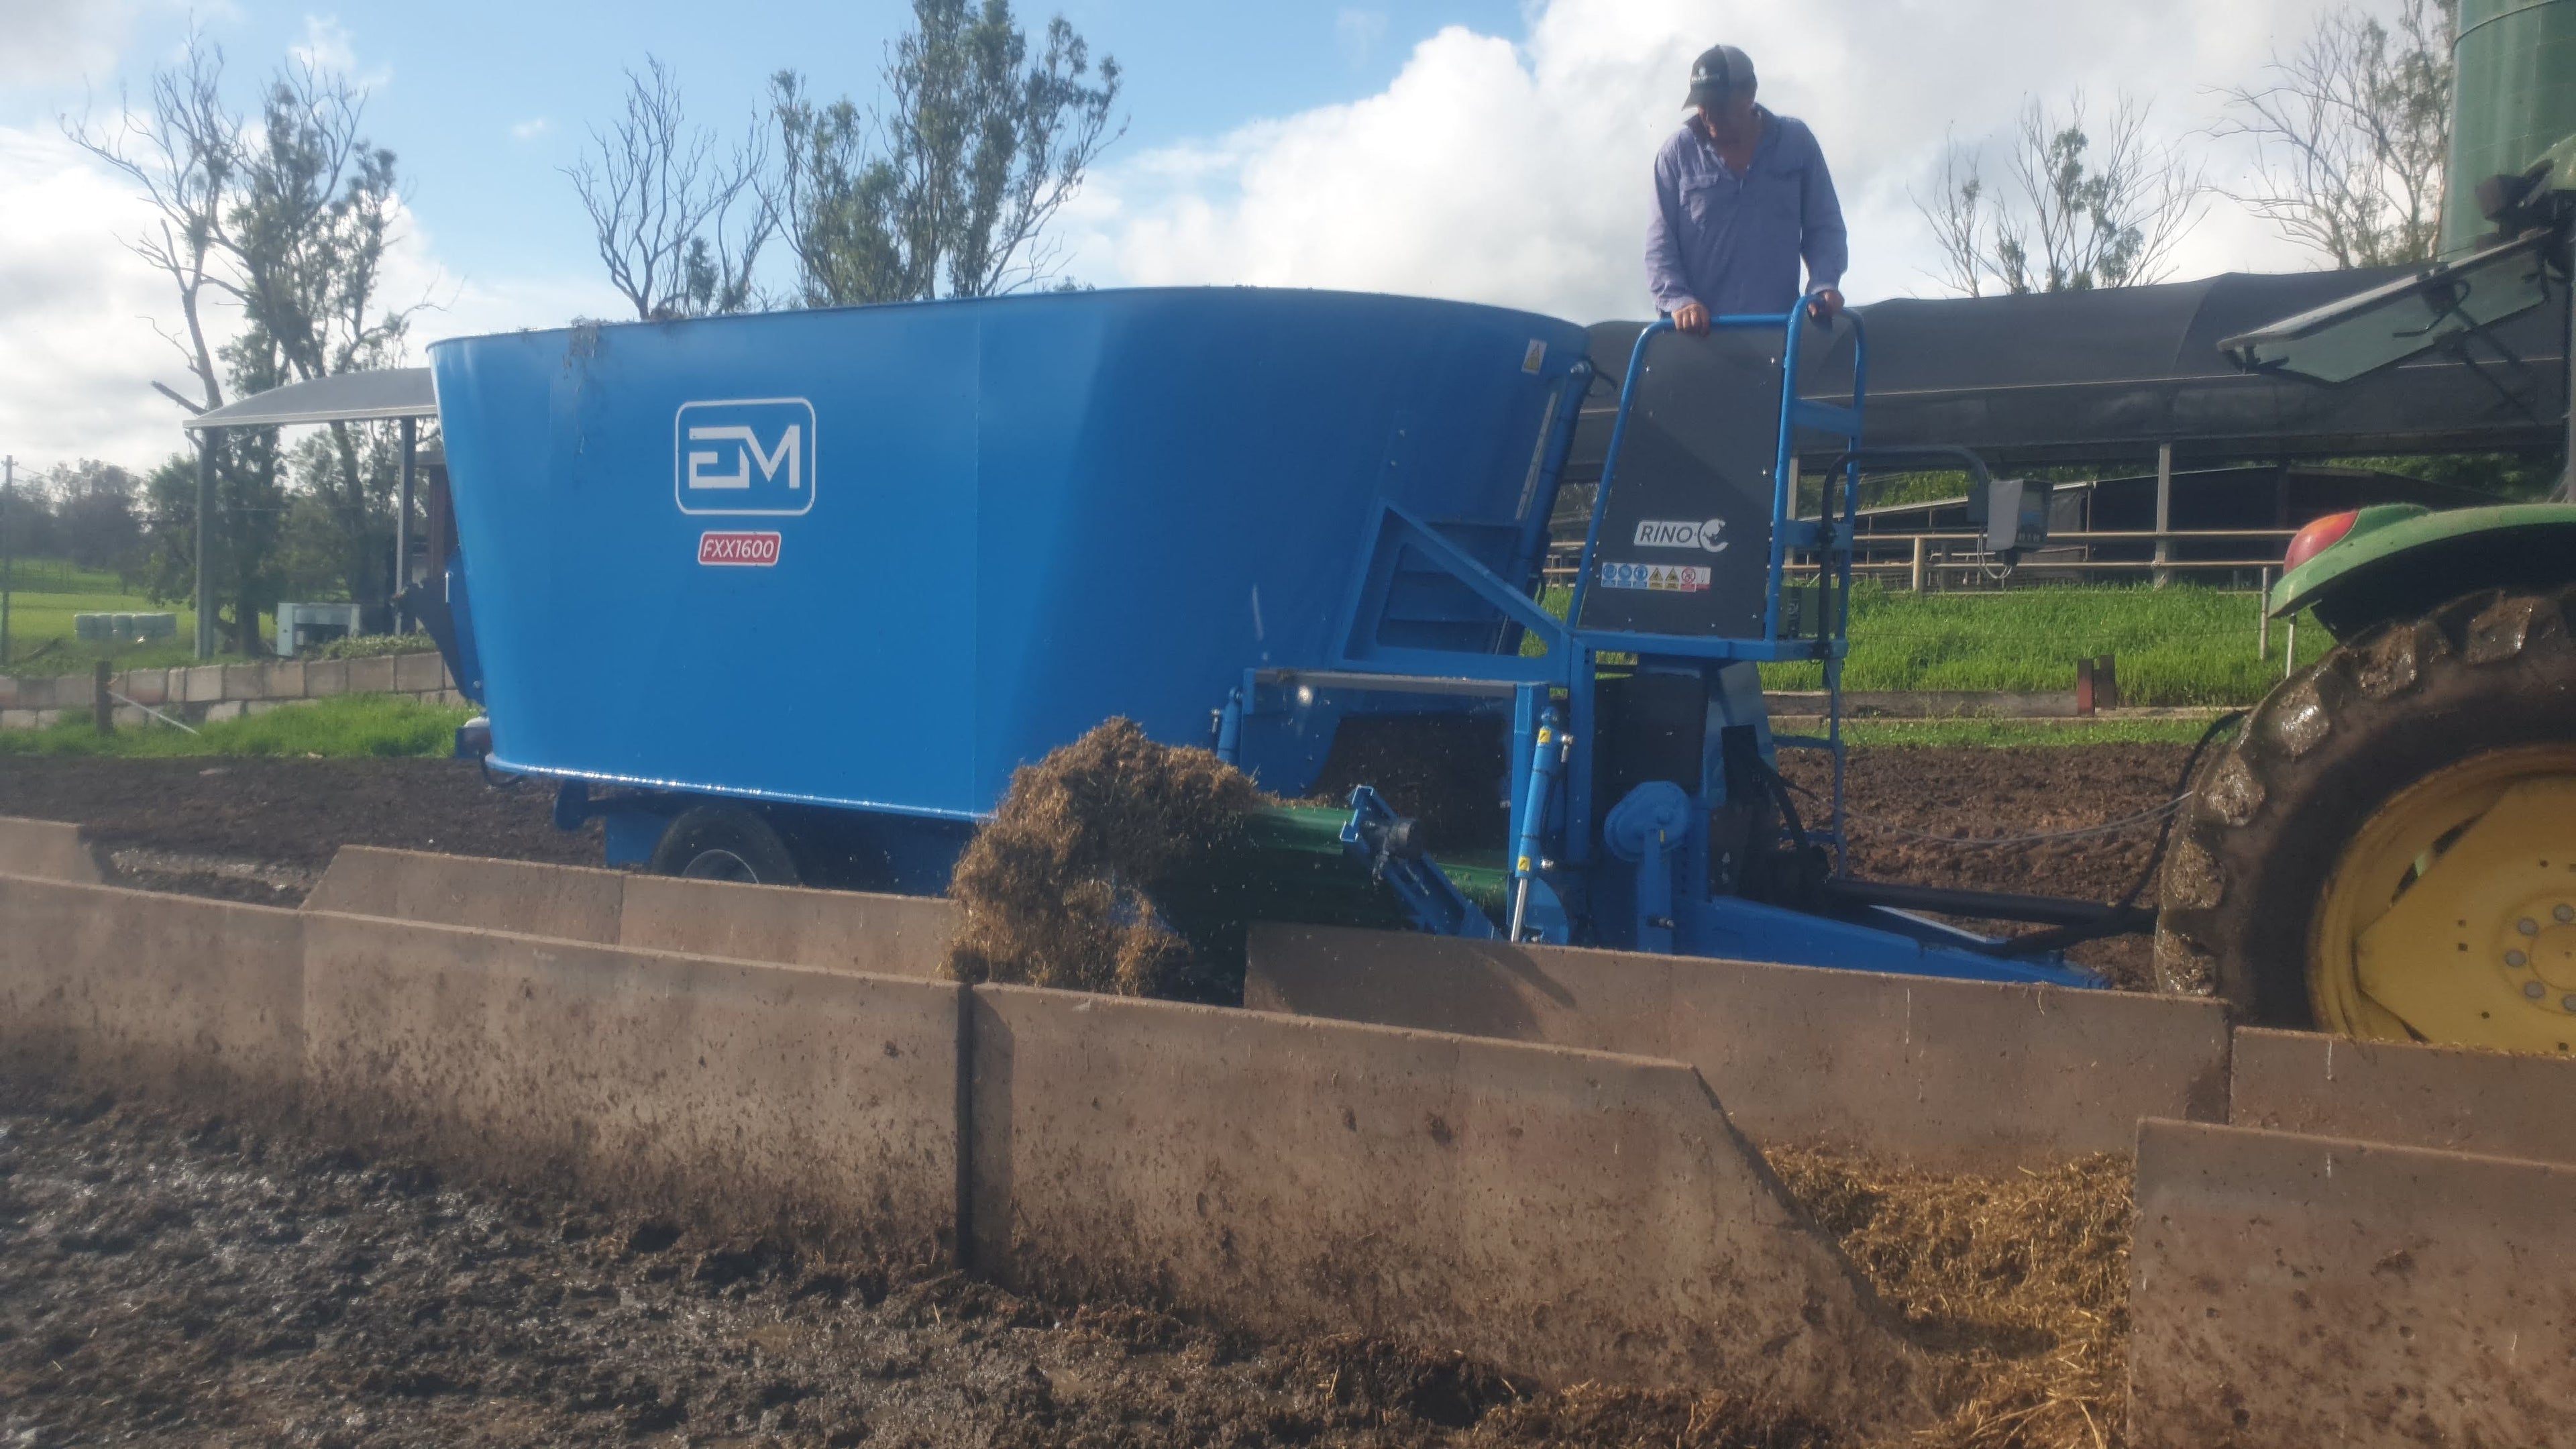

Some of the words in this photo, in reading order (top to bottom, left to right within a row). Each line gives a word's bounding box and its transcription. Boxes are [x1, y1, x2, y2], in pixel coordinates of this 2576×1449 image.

[689, 425, 800, 488] EM
[1639, 523, 1693, 543] RINO
[702, 539, 774, 558] FXX1600
